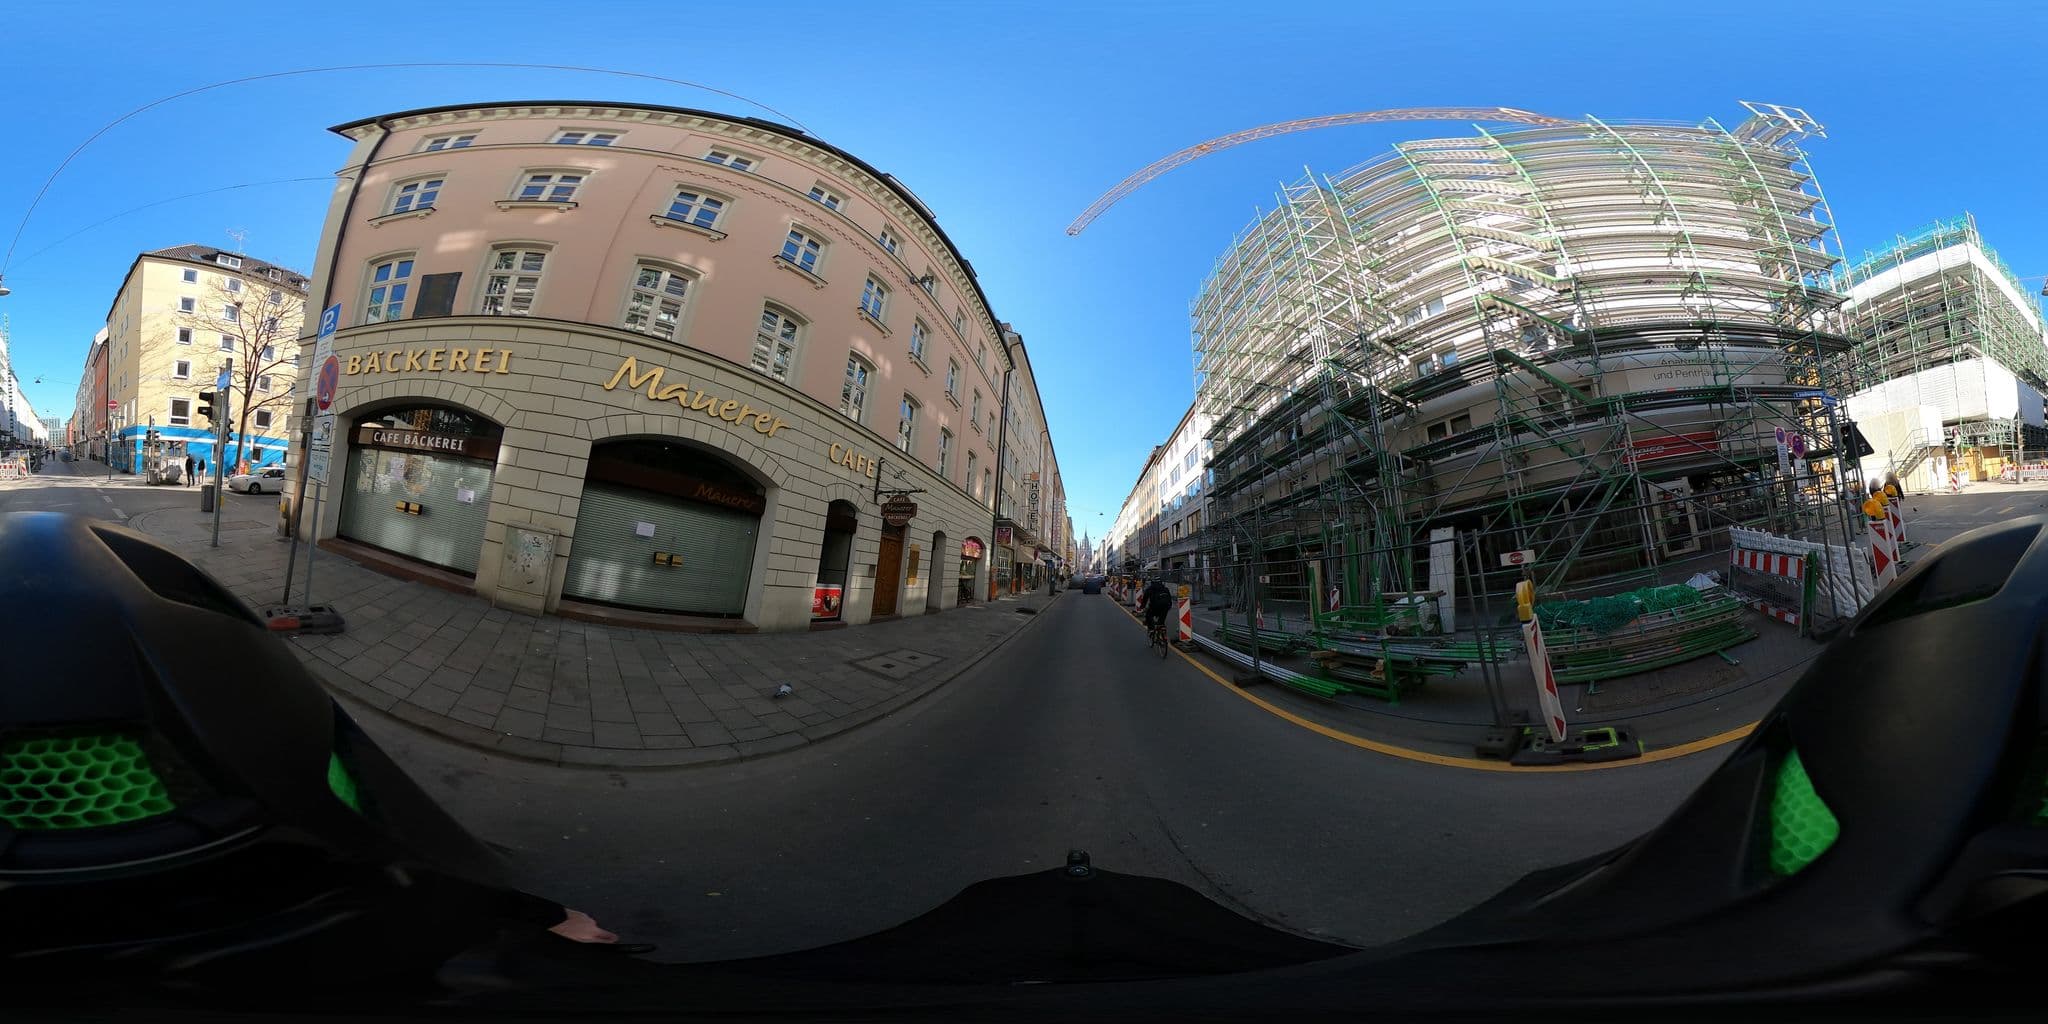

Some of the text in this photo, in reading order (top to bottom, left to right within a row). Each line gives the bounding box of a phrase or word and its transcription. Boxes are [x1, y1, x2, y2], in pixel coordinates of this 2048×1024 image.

[346, 347, 513, 375] BÄCKEREI
[603, 356, 792, 438] Mauerer
[374, 431, 464, 451] CAFE BÄCKEREI
[829, 443, 875, 479] CAFE
[1030, 482, 1038, 530] HOTEL
